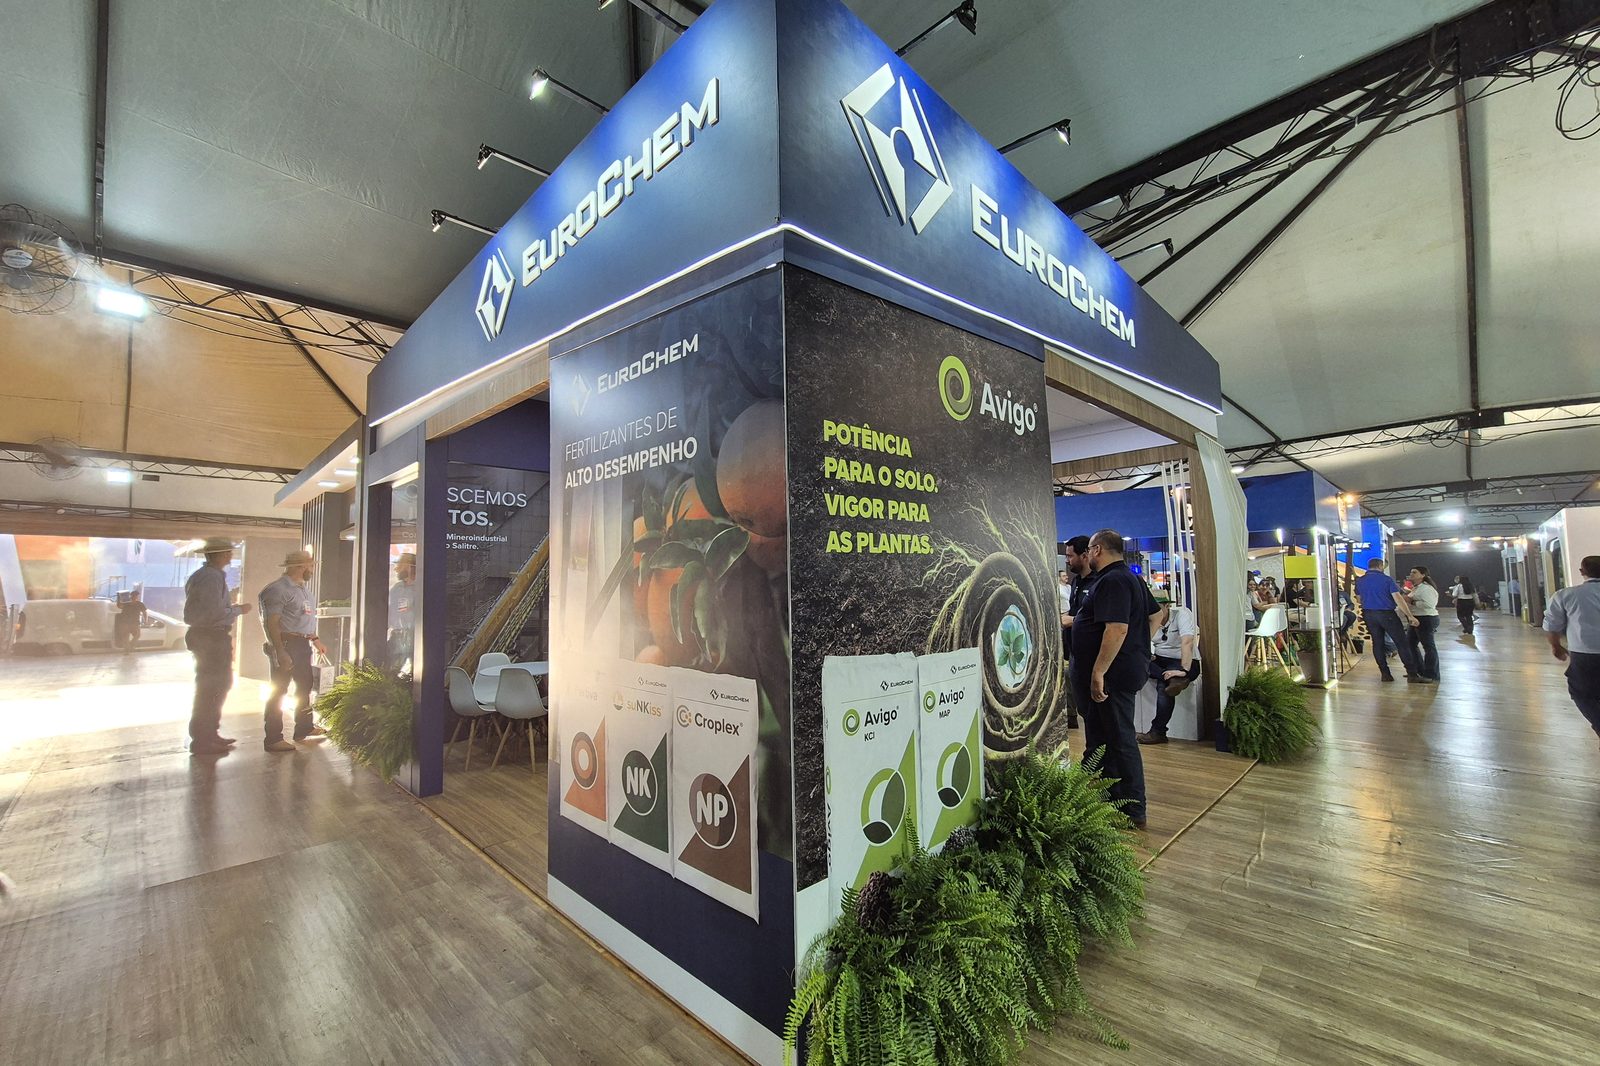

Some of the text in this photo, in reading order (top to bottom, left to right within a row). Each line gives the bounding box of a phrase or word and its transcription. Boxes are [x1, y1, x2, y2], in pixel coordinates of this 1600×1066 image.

[565, 406, 678, 462] FERTILIZANTES DE
[823, 419, 912, 458] POTÊNCIA
[565, 436, 698, 489] ALTO DESEMPENHO
[824, 456, 938, 493] PARA O SOLO.
[446, 487, 527, 507] SCEMOS
[824, 493, 930, 523] VIGOR PARA
[448, 509, 493, 527] TOS.
[446, 533, 508, 542] Mineroindustrial
[452, 542, 479, 550] Salitre.
[826, 530, 934, 555] AS PLANTAS.
[939, 709, 951, 719] MAP
[626, 766, 651, 798] NK
[697, 791, 728, 827] NP
